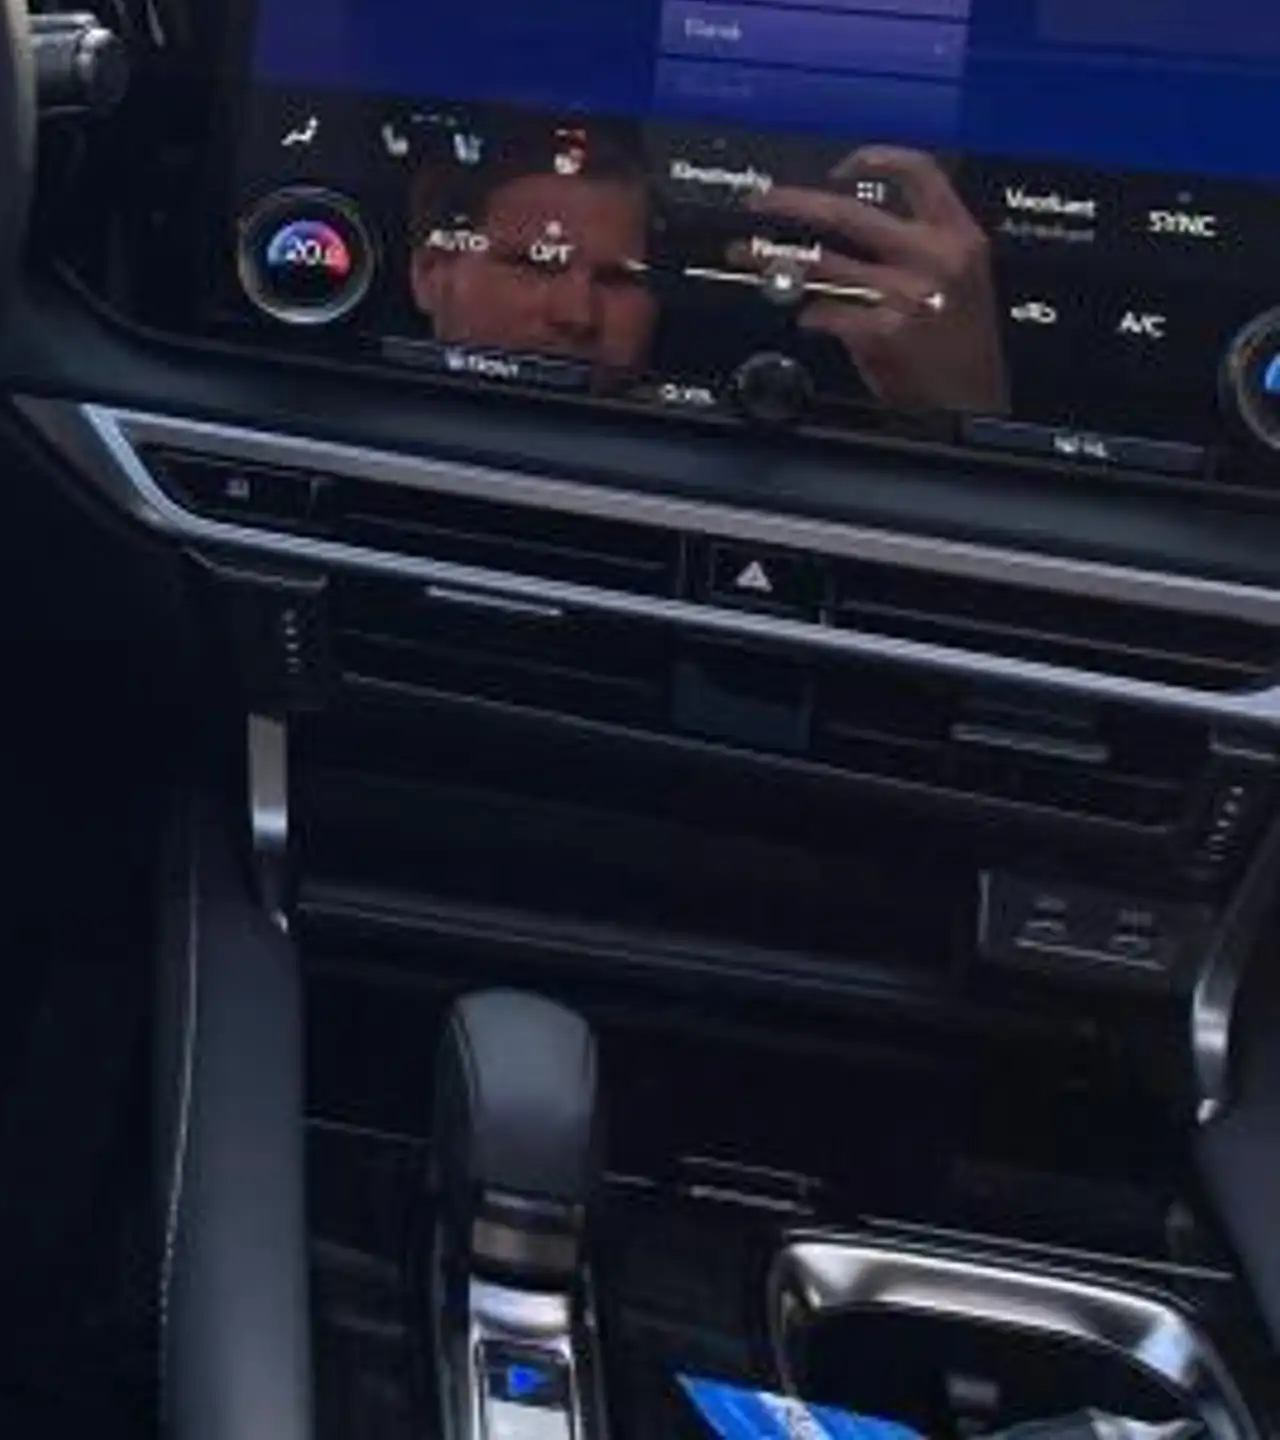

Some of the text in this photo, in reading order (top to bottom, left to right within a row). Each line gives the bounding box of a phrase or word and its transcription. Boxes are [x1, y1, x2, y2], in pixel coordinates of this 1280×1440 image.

[1148, 210, 1218, 238] SYNC
[426, 229, 490, 252] AUTO
[530, 241, 576, 264] OFF
[1118, 311, 1167, 338] A/C
